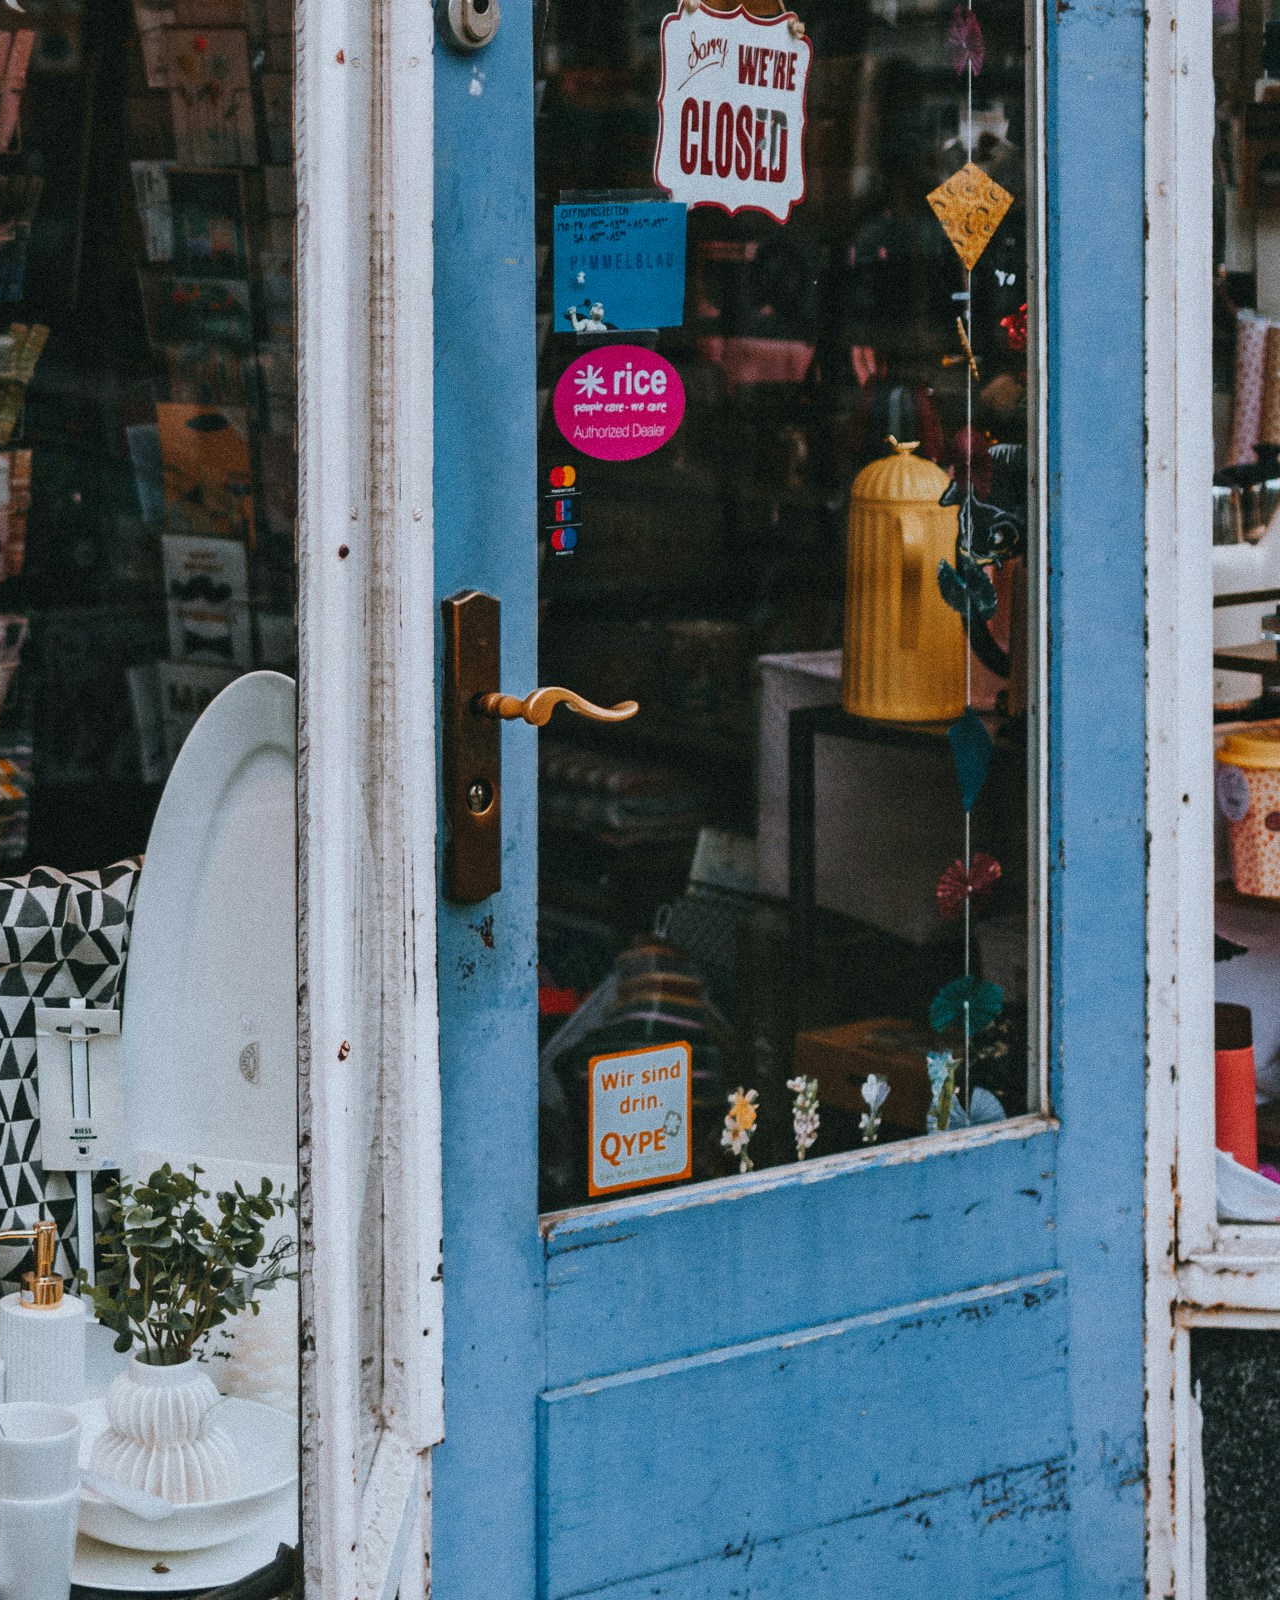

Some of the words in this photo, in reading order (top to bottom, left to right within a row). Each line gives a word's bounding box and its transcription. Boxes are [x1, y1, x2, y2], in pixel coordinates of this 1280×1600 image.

[688, 31, 728, 69] Sorry
[738, 44, 797, 91] WE'RE
[680, 97, 788, 183] CLOSED
[613, 362, 667, 395] rice
[574, 402, 603, 417] people
[631, 402, 645, 412] we
[573, 424, 630, 439] Authorized
[632, 423, 666, 438] Dealer
[601, 1070, 634, 1091] Wir
[641, 1060, 681, 1085] sind
[620, 1093, 663, 1114] drin.
[600, 1127, 666, 1167] QYPE
